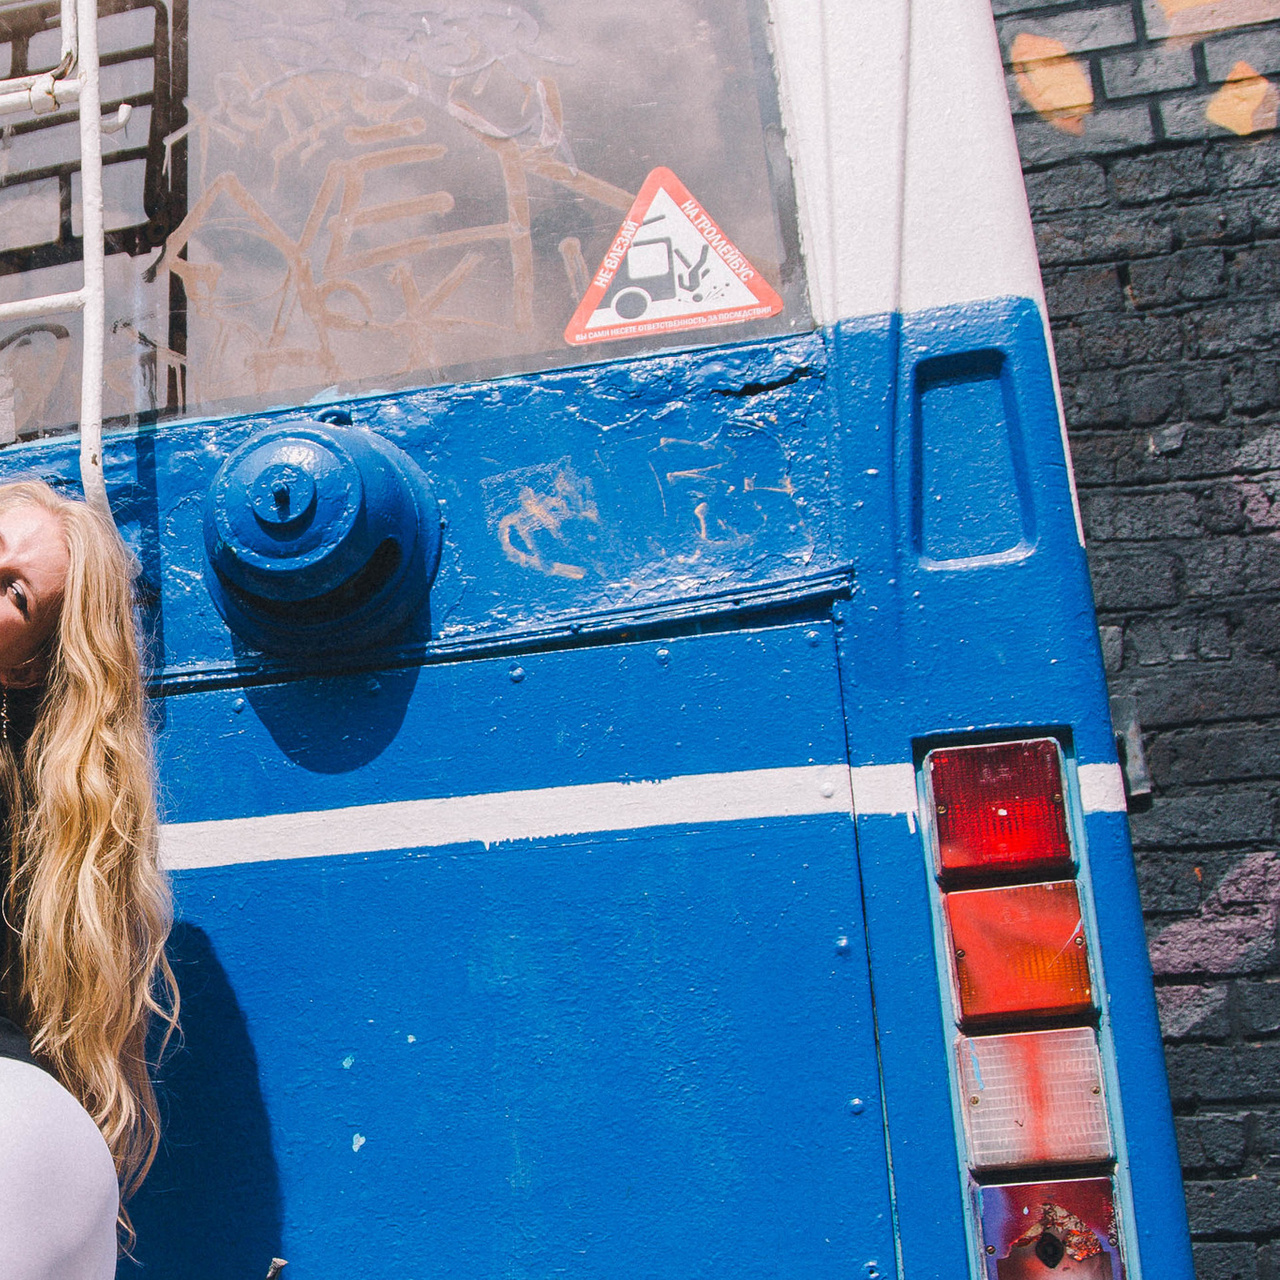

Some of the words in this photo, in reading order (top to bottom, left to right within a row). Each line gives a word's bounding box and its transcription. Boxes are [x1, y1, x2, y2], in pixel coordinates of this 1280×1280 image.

[594, 269, 613, 288] НЕ
[604, 220, 639, 269] ВЛЕЗАЙ
[681, 200, 699, 219] НА
[694, 214, 755, 282] ТРОЛЛЕЙБУС
[575, 332, 588, 342] ВЫ
[588, 330, 609, 339] САМИ
[610, 325, 637, 336] НЕСЕТЕ
[637, 315, 707, 333] ОТВЕТСТВЕННОСТЬ
[707, 315, 717, 323] ЗА
[718, 305, 773, 322] ПОСЛЕДСТВИЯ
